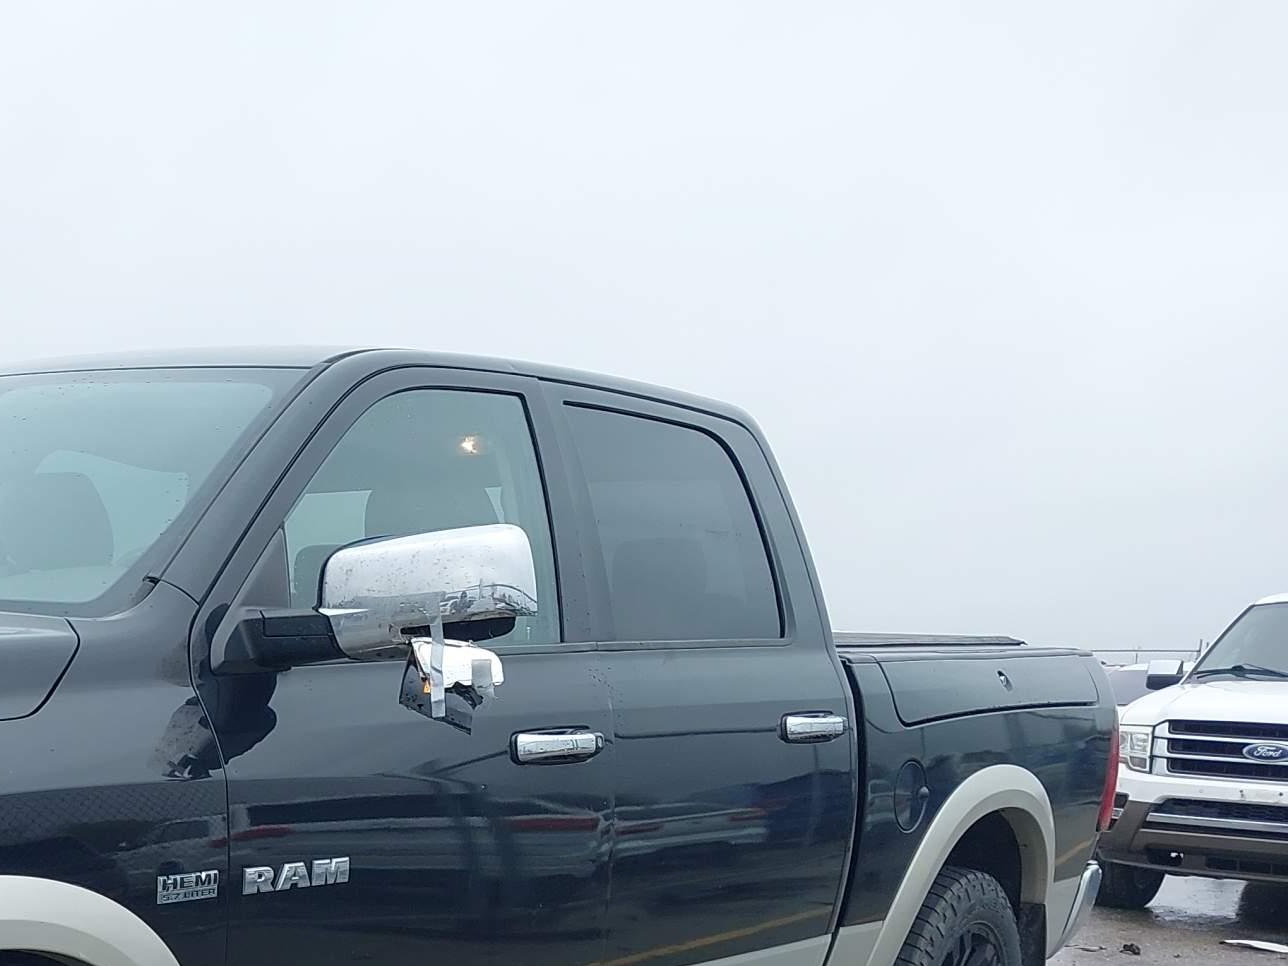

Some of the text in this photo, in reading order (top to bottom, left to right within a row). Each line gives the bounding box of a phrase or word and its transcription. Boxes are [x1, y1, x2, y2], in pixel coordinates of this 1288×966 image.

[1253, 745, 1283, 757] Ford
[160, 871, 218, 892] HEMI
[242, 856, 350, 895] RAM
[161, 888, 216, 902] 5.7 LITER
